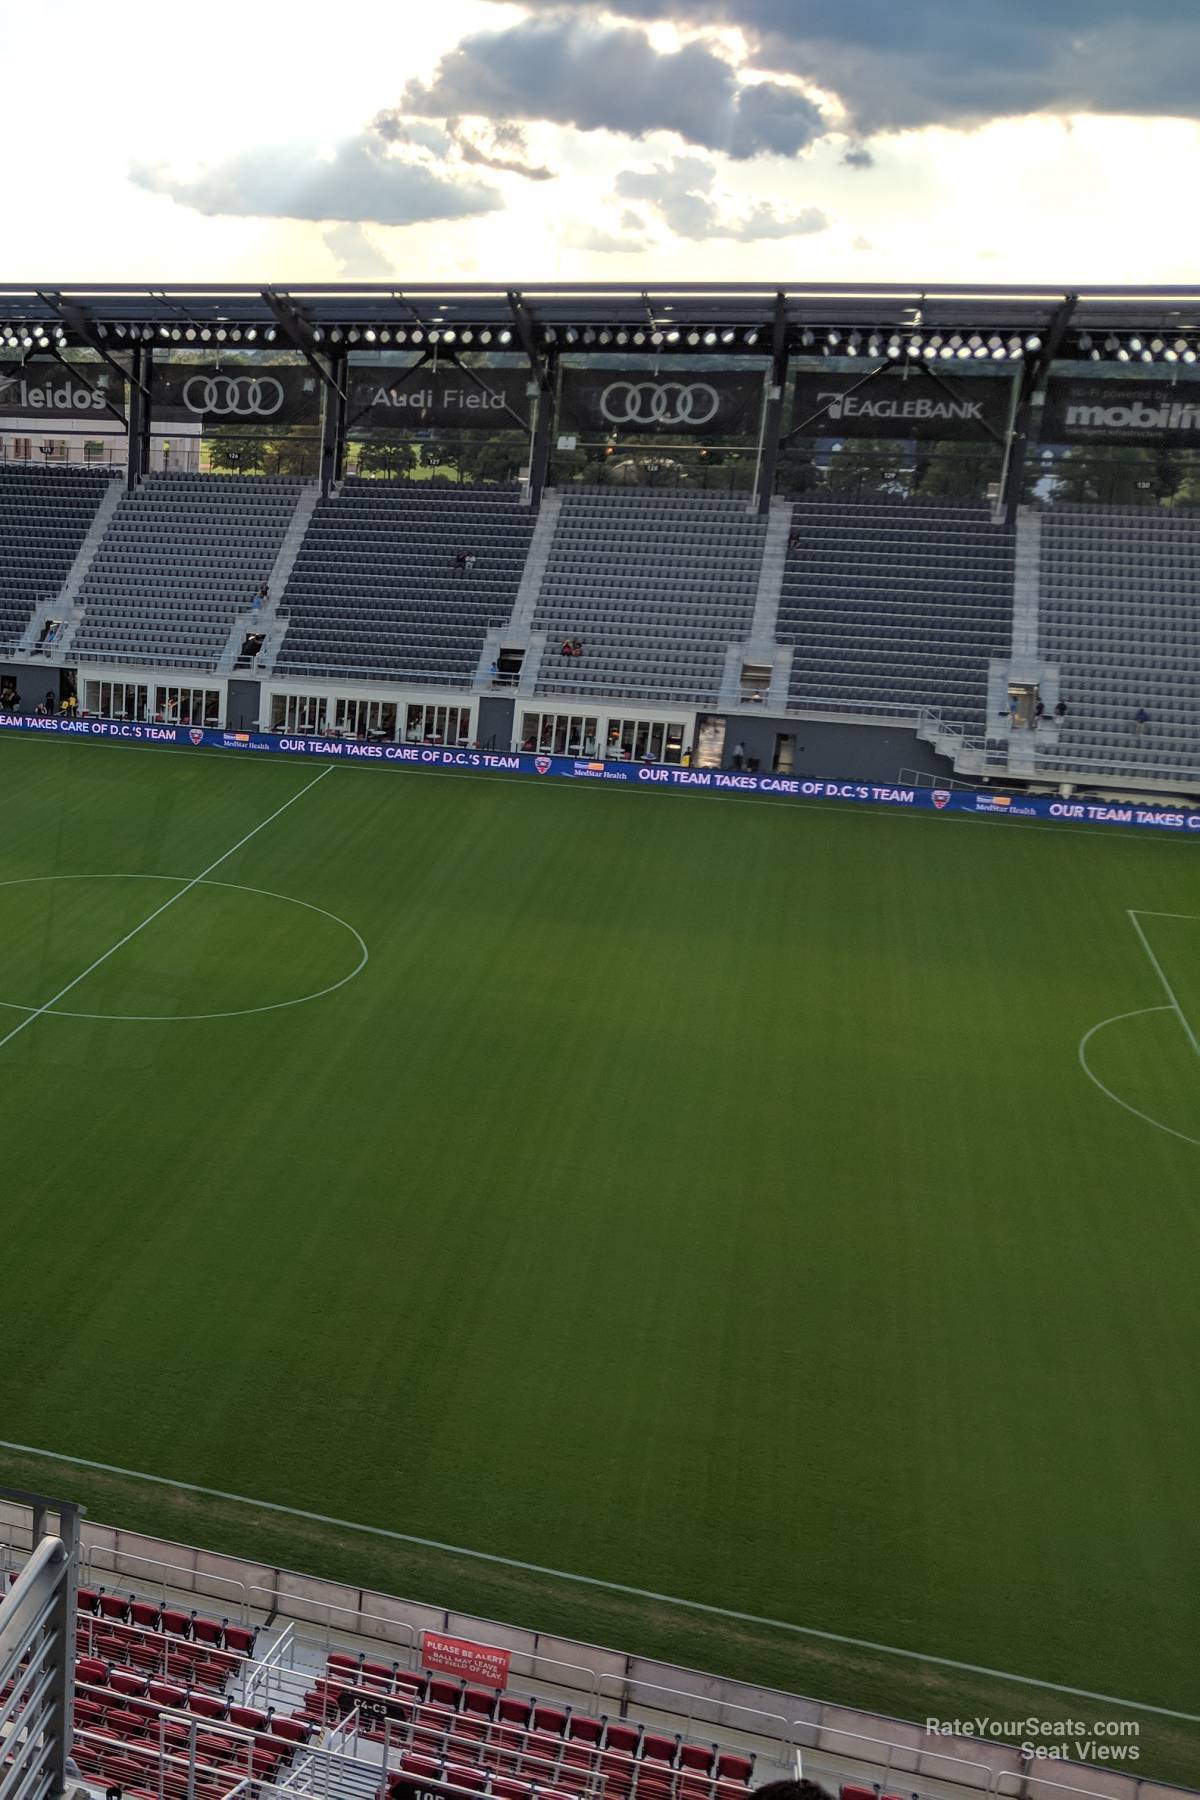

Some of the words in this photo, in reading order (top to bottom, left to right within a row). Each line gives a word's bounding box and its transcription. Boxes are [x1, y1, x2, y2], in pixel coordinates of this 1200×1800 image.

[20, 380, 107, 409] leidos
[371, 387, 433, 408] Audi
[443, 389, 506, 409] Field
[25, 716, 58, 730] TAKES
[60, 719, 89, 733] CARE
[91, 722, 107, 735] OF
[144, 727, 176, 740] TEAM
[223, 740, 248, 749] MedStar
[249, 742, 270, 751] Health
[279, 738, 305, 751] OUR
[308, 741, 342, 754] TEAM
[345, 744, 382, 758] TAKES
[385, 747, 418, 760] CARE
[421, 750, 440, 762] OF
[483, 755, 519, 769] TEAM
[574, 768, 602, 778] MedStar
[603, 770, 627, 780] Health
[638, 768, 669, 782] OUR
[671, 770, 711, 786] TEAM
[714, 773, 757, 790] TAKES
[760, 777, 799, 793] CARE
[801, 781, 823, 796] OF
[872, 786, 914, 803] TEAM
[976, 803, 1009, 813] MedStar
[1009, 805, 1036, 816] Health
[1049, 803, 1084, 818] OUR
[1087, 806, 1133, 822] TEAM
[1136, 809, 1184, 827] TAKES
[427, 1640, 461, 1656] PLEASE
[462, 1648, 474, 1658] BE
[474, 1653, 506, 1666] ALERT!
[433, 1652, 453, 1661] BALL
[454, 1656, 474, 1665] MAY
[474, 1660, 498, 1673] LEAVE
[427, 1655, 443, 1664] THE
[444, 1658, 469, 1670] FIELD
[469, 1663, 481, 1674] OF
[353, 1698, 388, 1715] C4-C3
